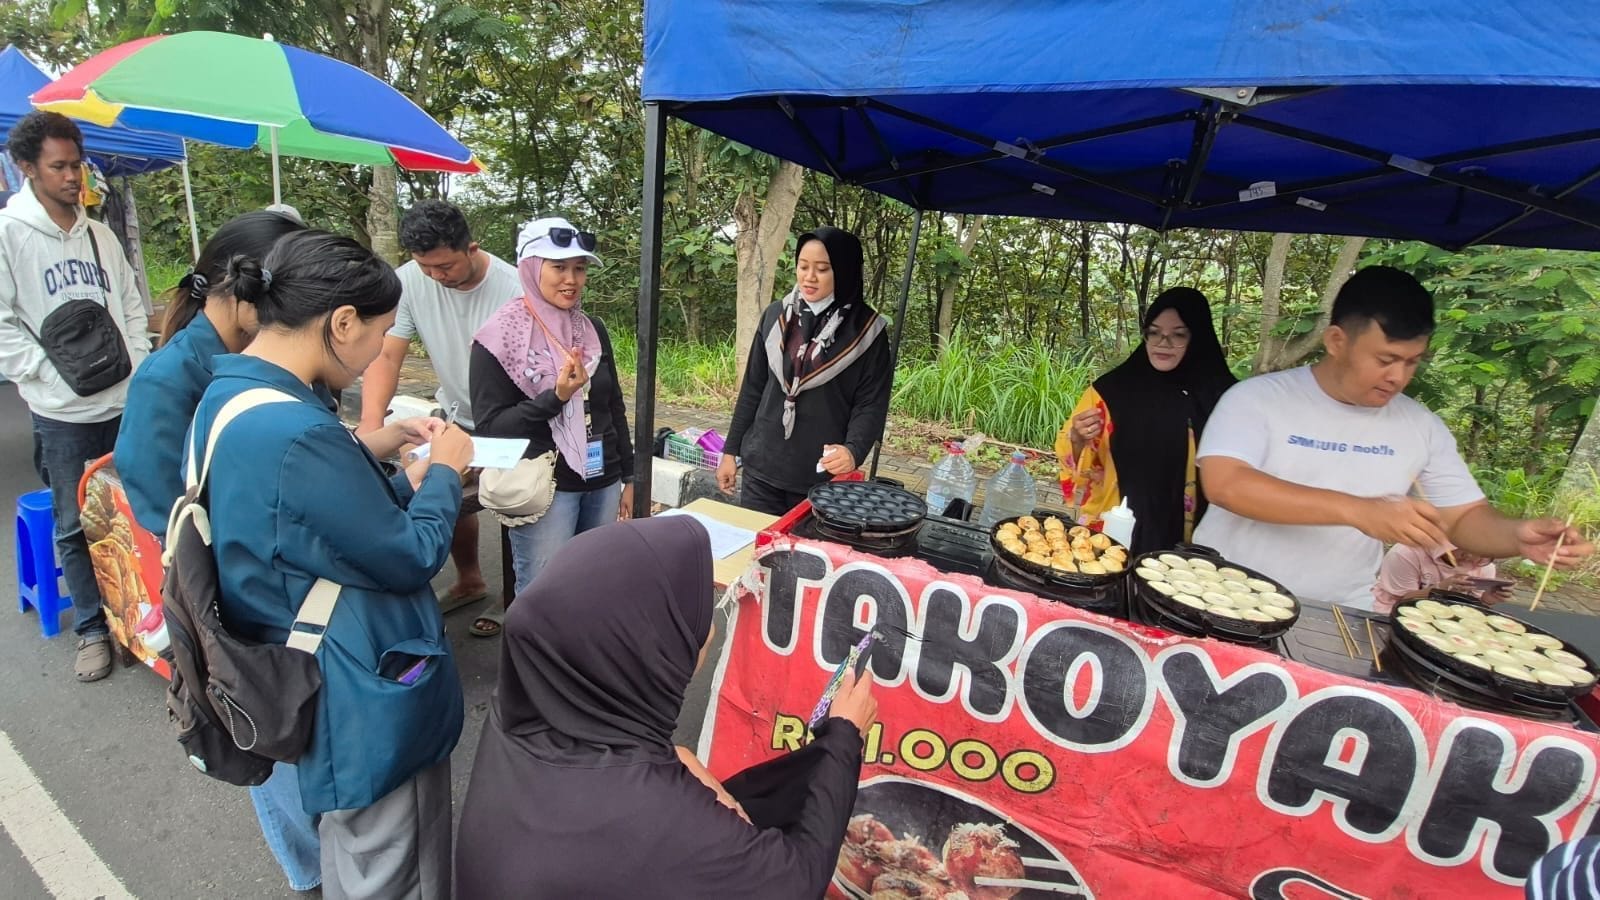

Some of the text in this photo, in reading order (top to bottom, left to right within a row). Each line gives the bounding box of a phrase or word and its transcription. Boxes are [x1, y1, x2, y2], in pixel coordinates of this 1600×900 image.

[44, 259, 111, 295] OXFORD
[756, 546, 1600, 884] TAKOYAK
[771, 712, 816, 752] R
